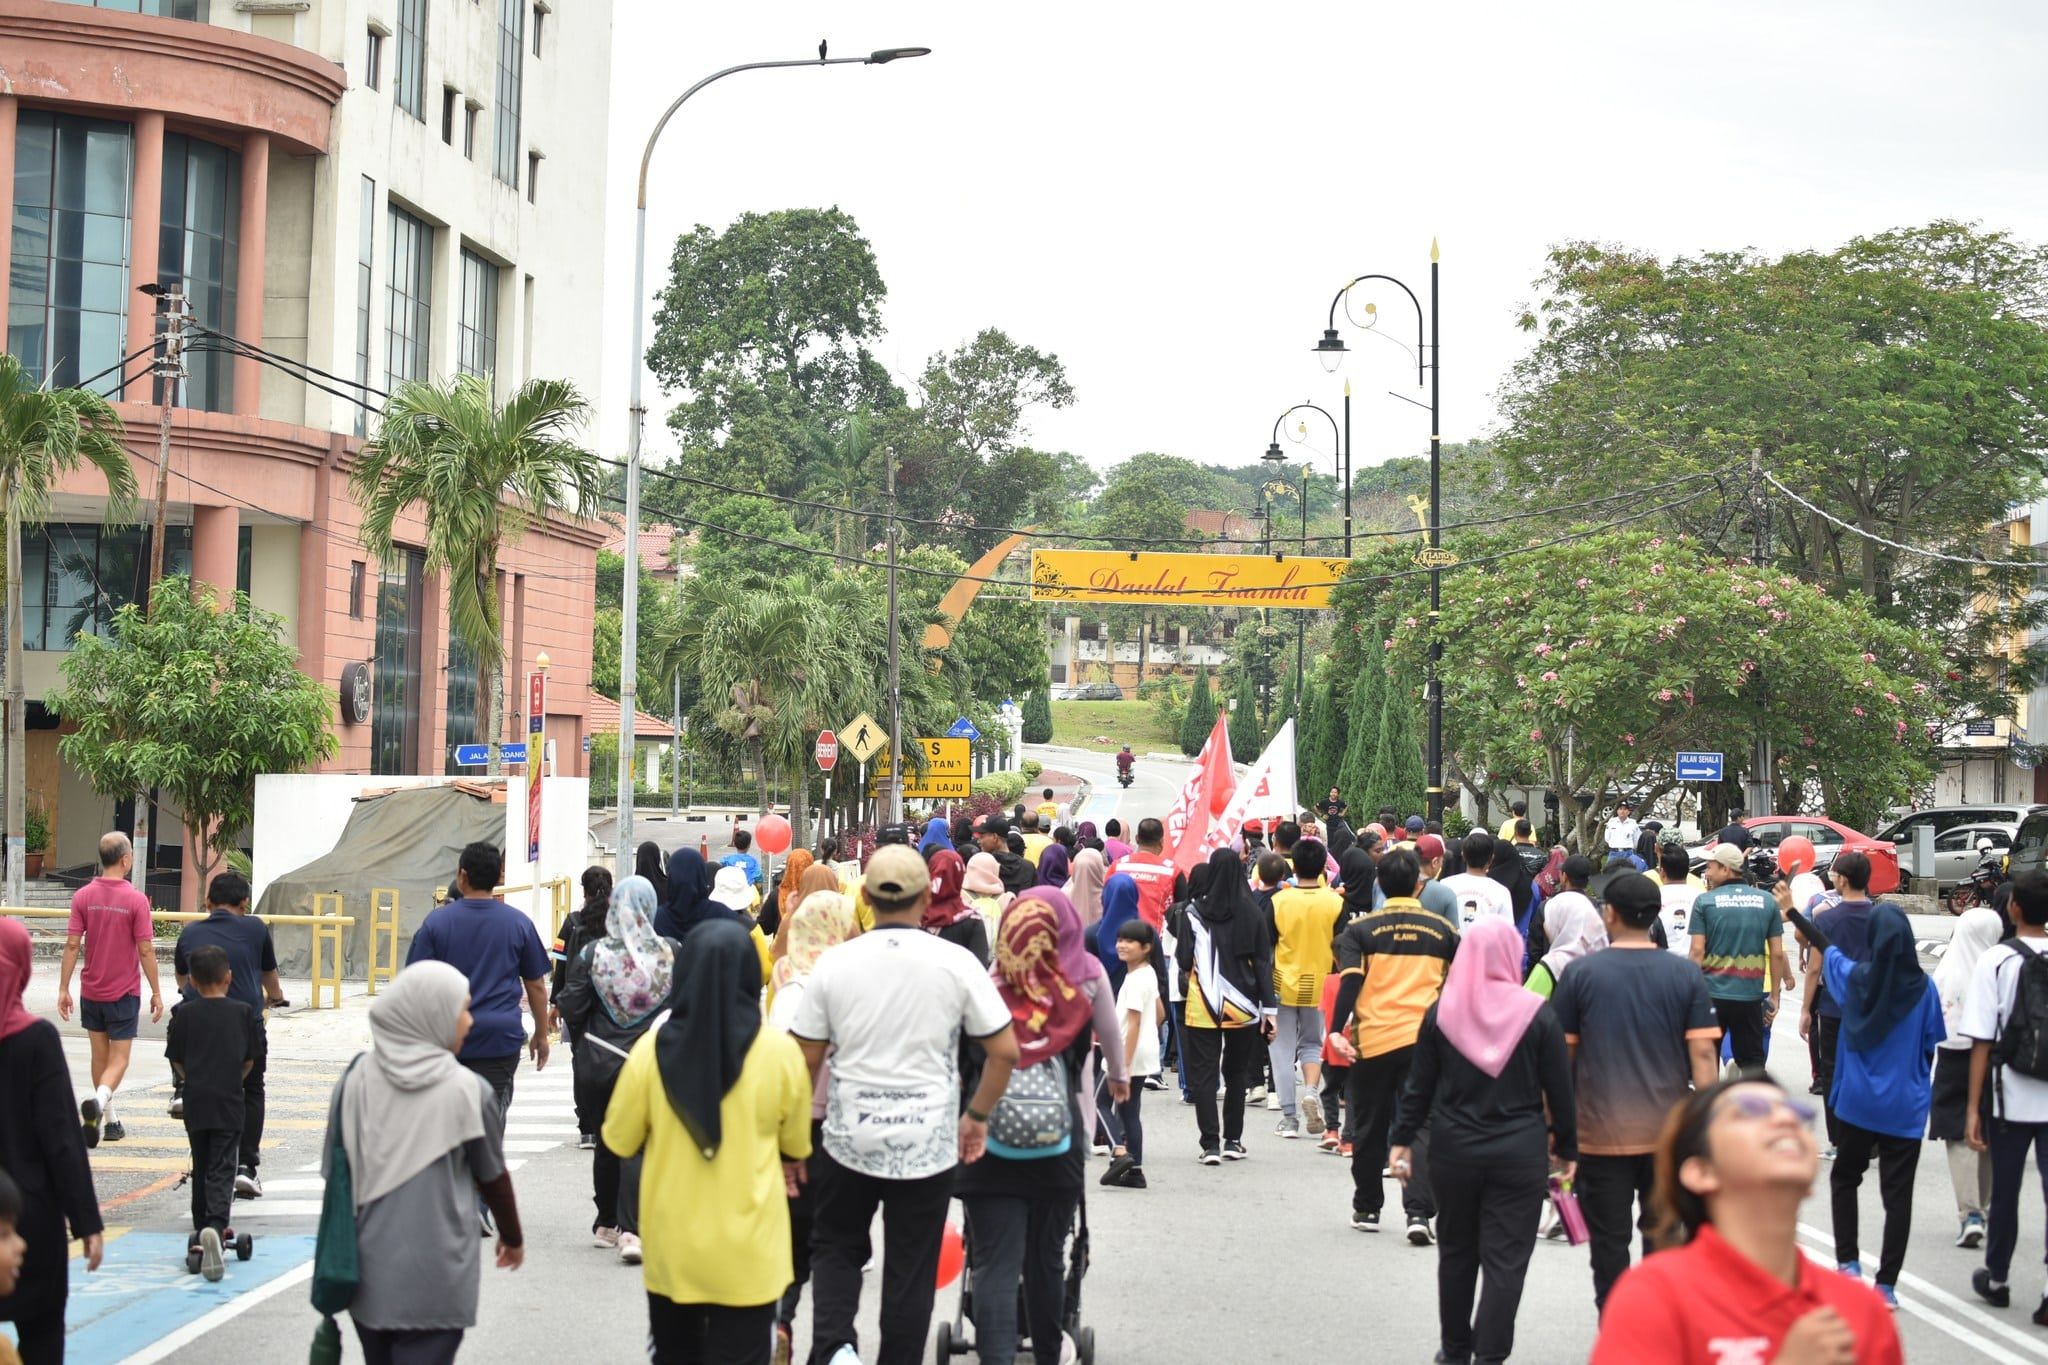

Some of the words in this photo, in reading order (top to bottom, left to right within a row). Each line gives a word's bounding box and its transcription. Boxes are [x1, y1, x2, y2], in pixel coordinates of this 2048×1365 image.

[1087, 568, 1187, 596] Daulat
[1201, 564, 1308, 600] Tuanku
[469, 752, 488, 760] JALA
[500, 751, 526, 759] ADANG
[1680, 755, 1697, 763] JALAN
[1698, 755, 1719, 764] SEHALA
[936, 783, 963, 792] LAJU
[1714, 894, 1765, 903] SELANGOR
[872, 1115, 924, 1125] DAIKIN
